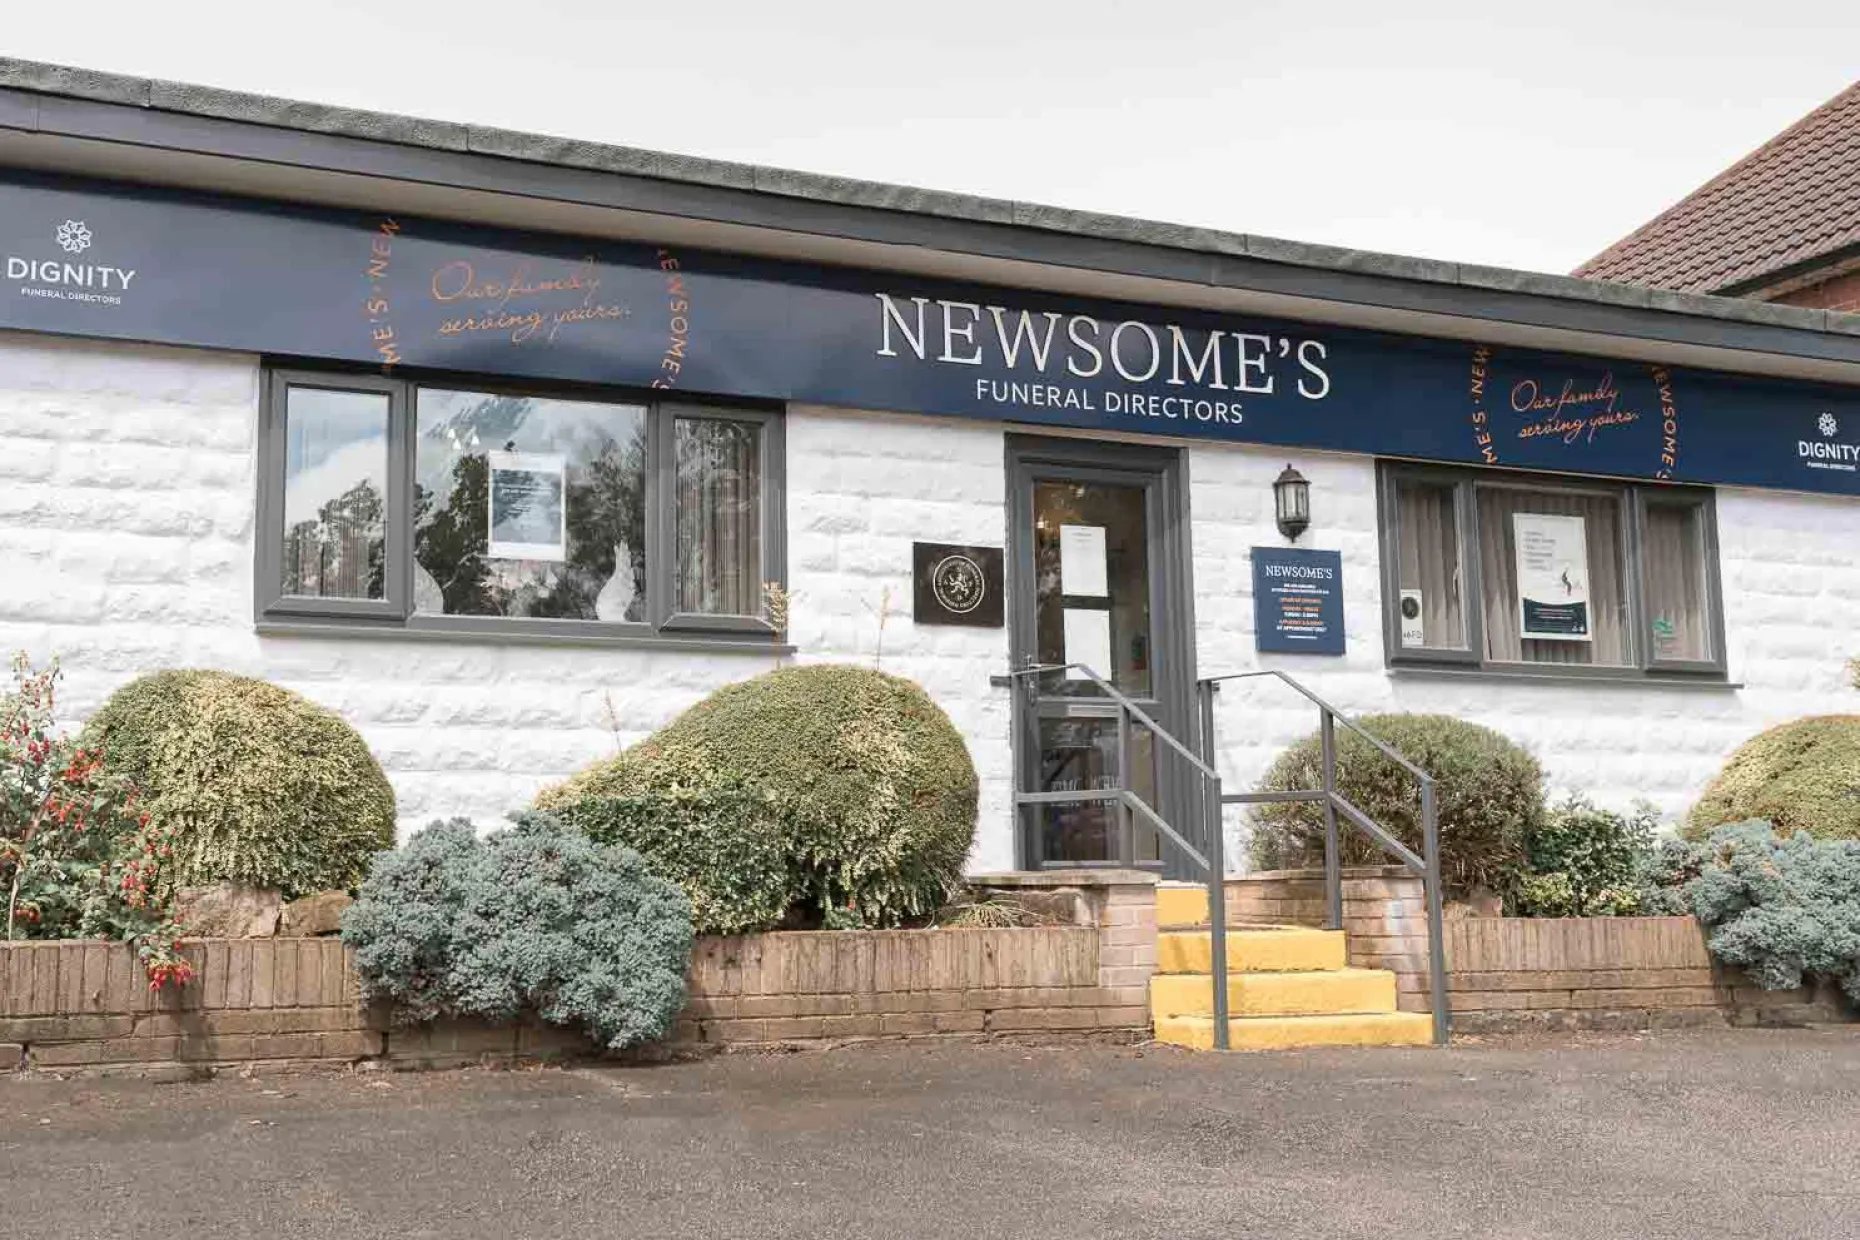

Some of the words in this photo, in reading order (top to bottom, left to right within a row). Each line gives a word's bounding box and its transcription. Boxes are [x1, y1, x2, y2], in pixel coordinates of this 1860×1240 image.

[7, 257, 136, 290] DIGNITY
[21, 287, 66, 300] FUNERAL
[68, 292, 121, 305] DIRECTORS
[874, 292, 1332, 401] NEWSOME'S
[976, 378, 1095, 411] FUNERAL
[1105, 391, 1244, 425] DIRECTORS
[1511, 379, 1557, 412] Our
[1551, 369, 1619, 418] family
[1518, 418, 1585, 444] serving
[1798, 439, 1860, 461] DIGNITY
[1265, 564, 1334, 579] NEWSOME'S
